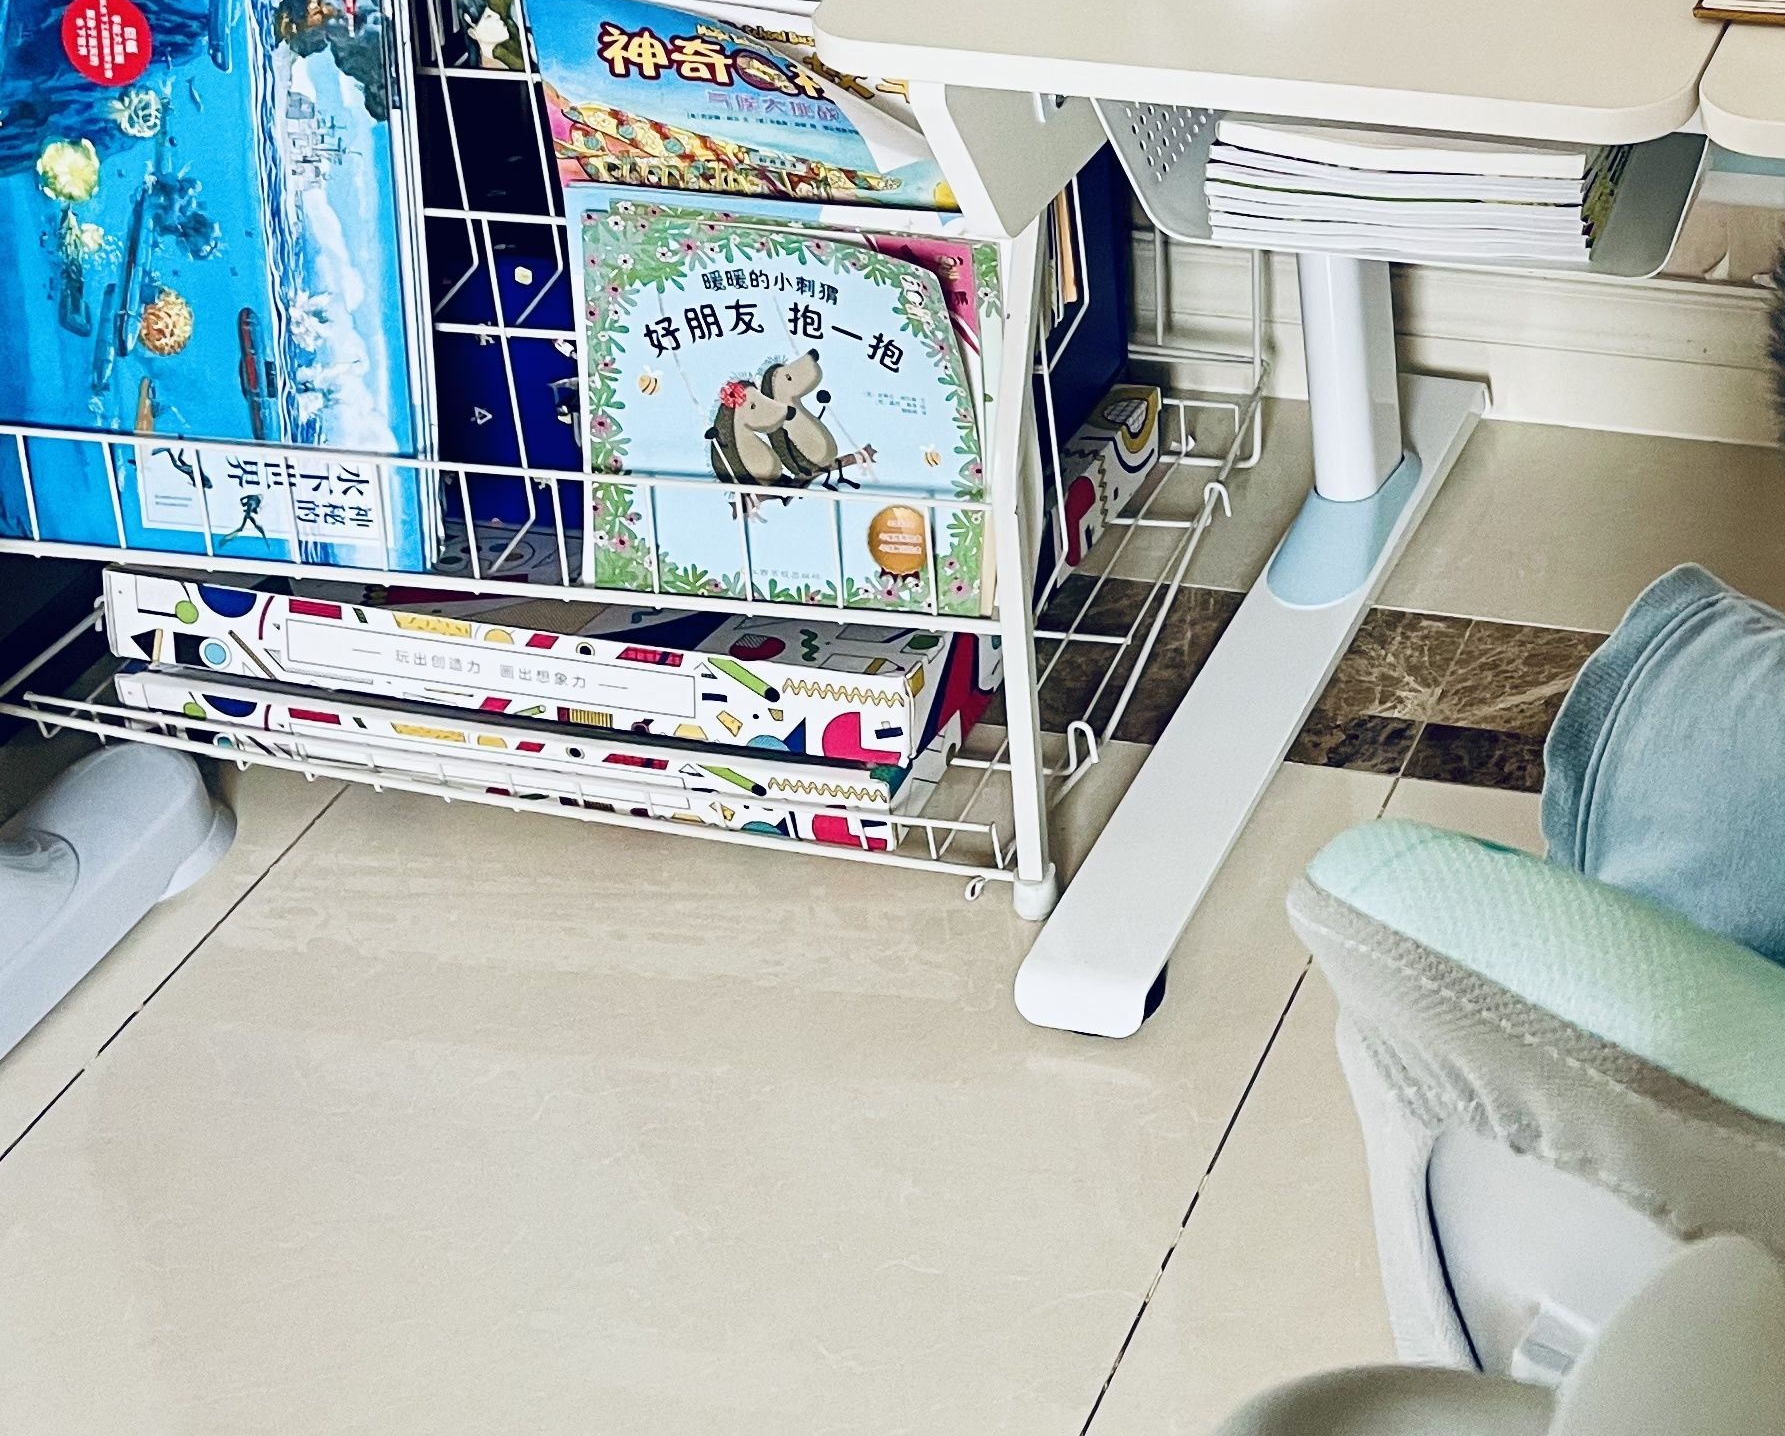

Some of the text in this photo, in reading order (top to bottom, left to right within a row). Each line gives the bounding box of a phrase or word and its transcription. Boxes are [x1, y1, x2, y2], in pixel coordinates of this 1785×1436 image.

[701, 269, 839, 305] 暖暖的小刺猬
[643, 298, 905, 373] 好朋友 抱一抱
[394, 647, 588, 691] 玩出创造力 画出想象力
